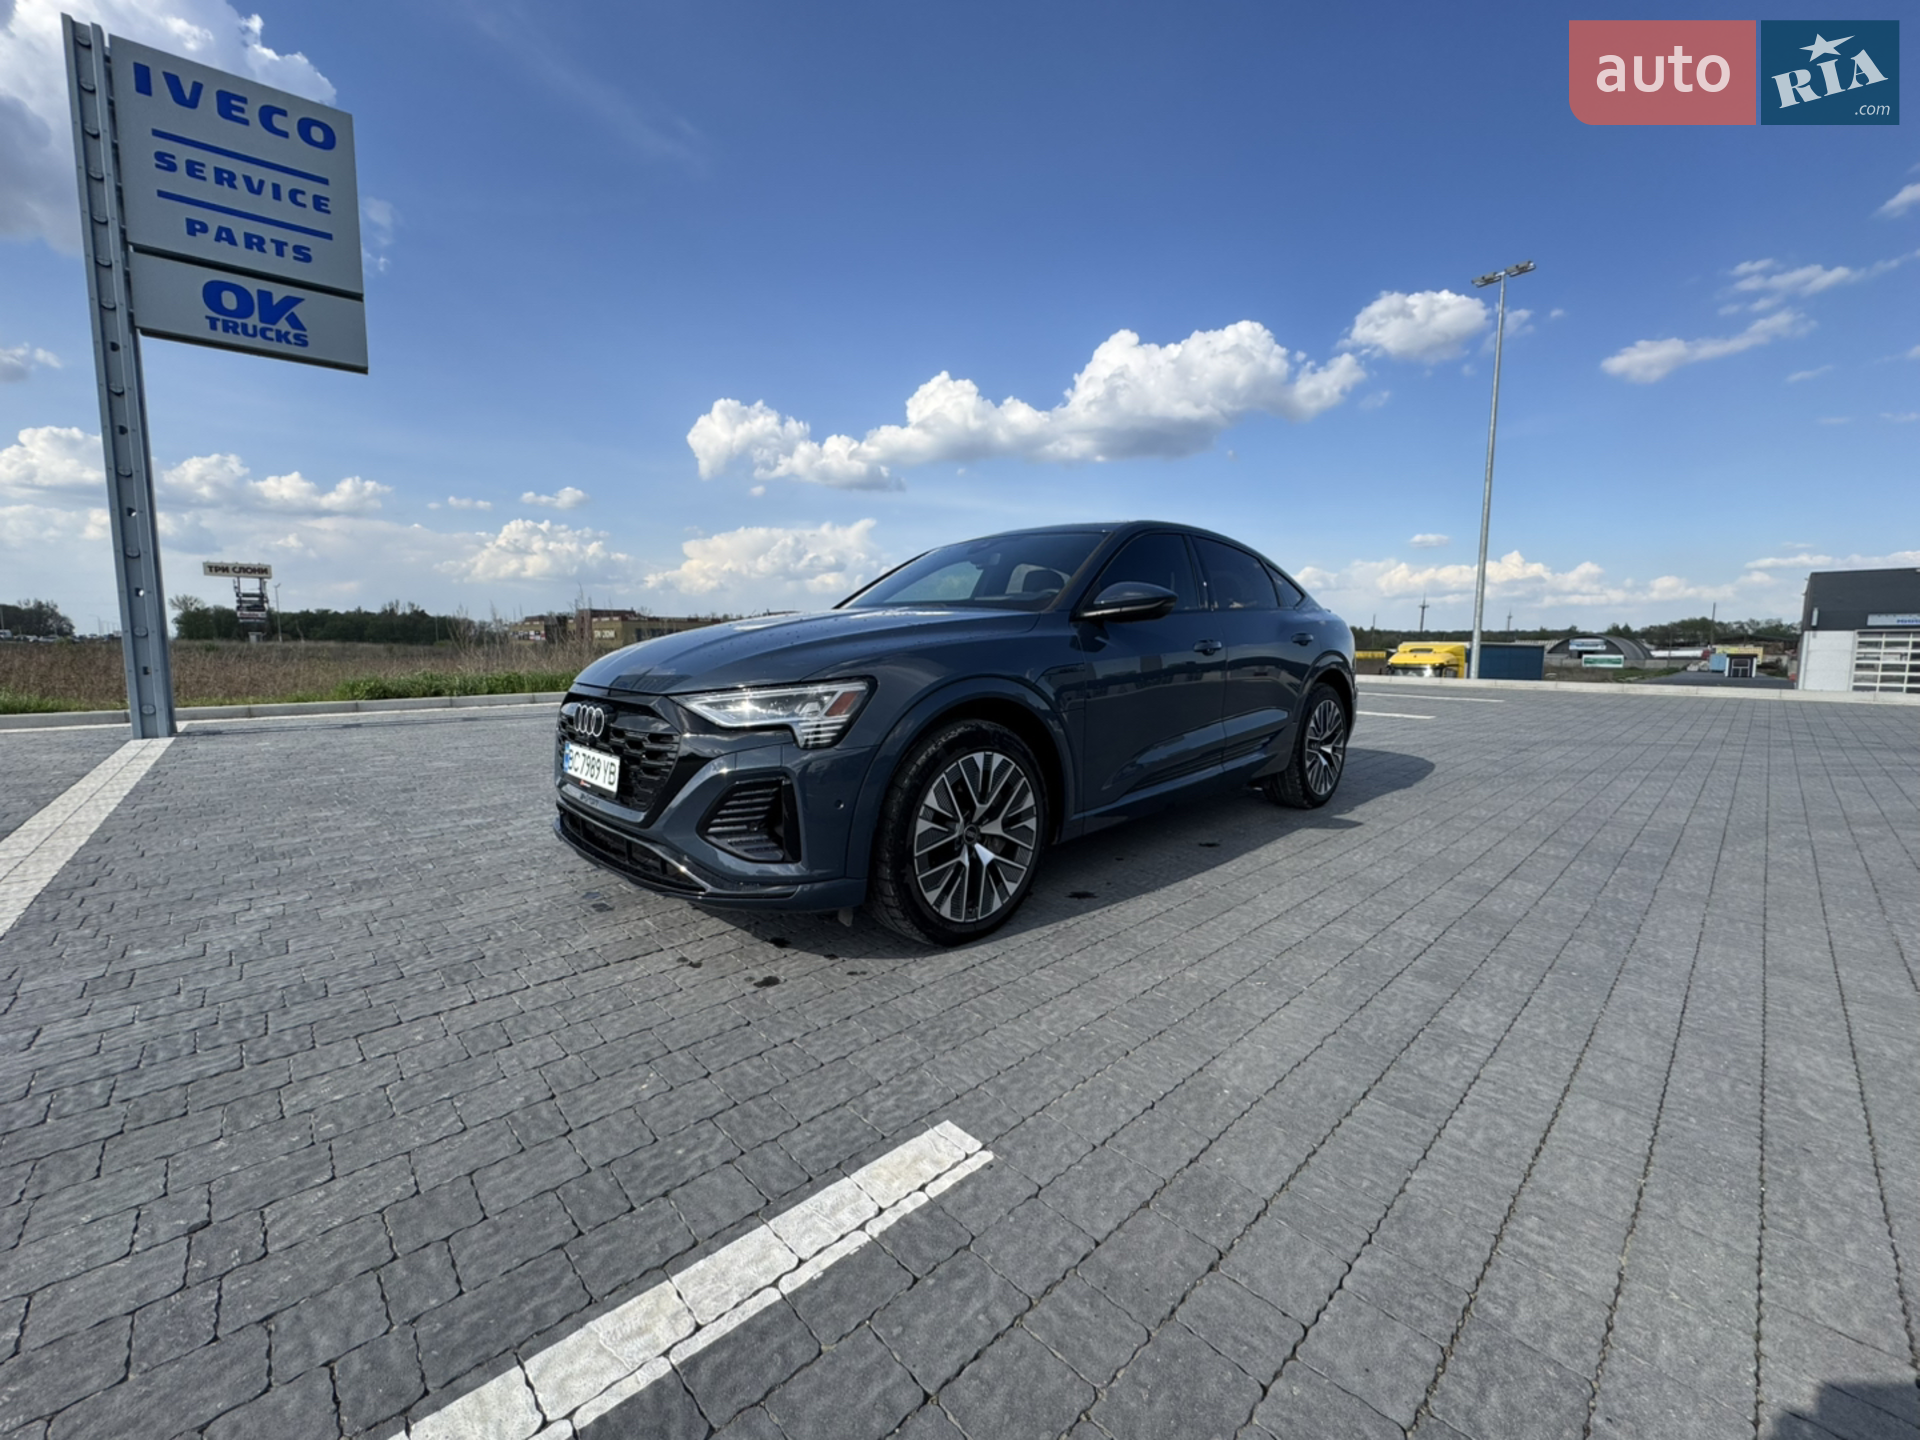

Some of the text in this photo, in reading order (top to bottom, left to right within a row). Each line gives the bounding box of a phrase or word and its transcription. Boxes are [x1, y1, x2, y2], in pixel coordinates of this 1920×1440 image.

[133, 61, 337, 151] IVECO
[153, 150, 332, 215] SERVICE
[185, 217, 313, 263] PARTS
[202, 279, 307, 332] OK
[205, 315, 309, 348] TRUCKS
[207, 565, 269, 575] ТРИ СЛОНИ
